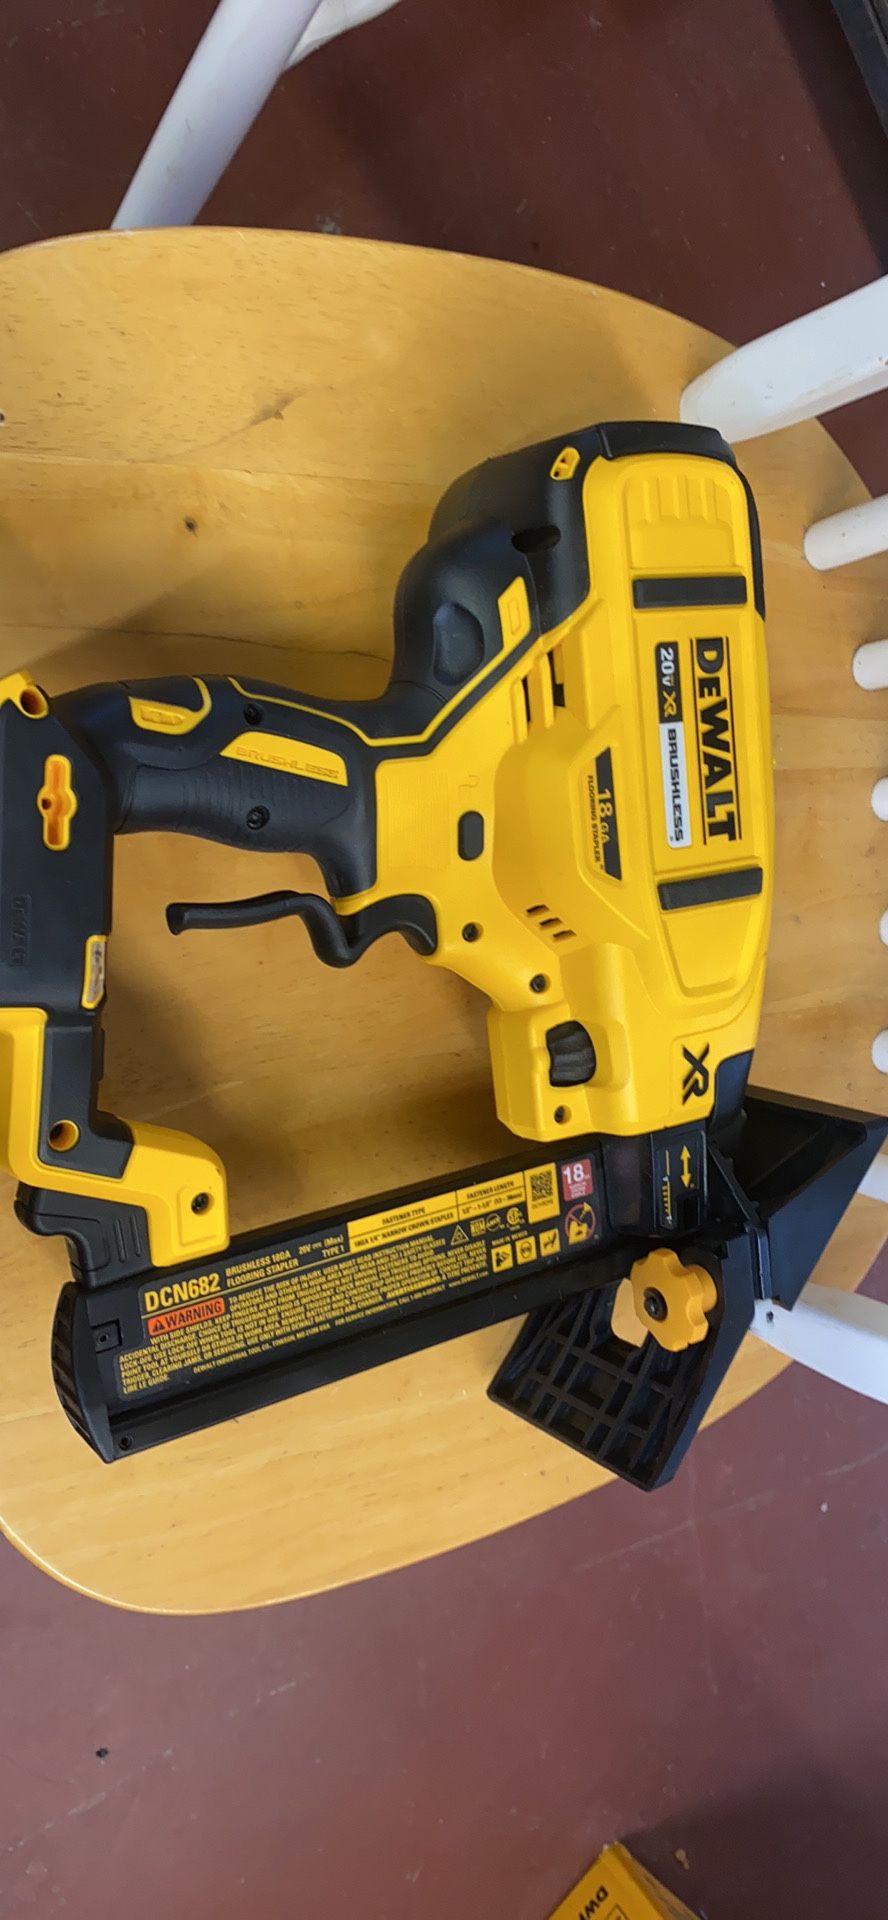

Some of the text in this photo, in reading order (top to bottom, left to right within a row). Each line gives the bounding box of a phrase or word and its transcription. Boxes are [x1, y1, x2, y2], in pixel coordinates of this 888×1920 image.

[663, 690, 677, 718] XR
[696, 637, 737, 842] DEWALT
[236, 747, 339, 778] BRUSHLESS
[667, 728, 684, 842] BRUSHLESS
[596, 788, 613, 817] 18
[587, 774, 601, 863] FLOORING STAPLER
[681, 1042, 710, 1106] XR
[563, 1163, 584, 1185] 18
[466, 1186, 493, 1200] FASTENER
[493, 1180, 514, 1192] LENGTH
[382, 1206, 426, 1226] FASTENER TYPE
[382, 1226, 408, 1240] NARROW
[408, 1219, 429, 1232] CROWN
[430, 1212, 454, 1225] STAPLES
[225, 1256, 271, 1277] BRUSHLESS
[272, 1250, 291, 1263] 18GA
[226, 1268, 265, 1288] FLOORING
[265, 1258, 299, 1276] STAPLER
[322, 1246, 340, 1258] TYPE
[144, 1272, 221, 1313] DCN682
[166, 1300, 221, 1328] WARNING
[119, 1344, 159, 1363] ACCIDENTAL
